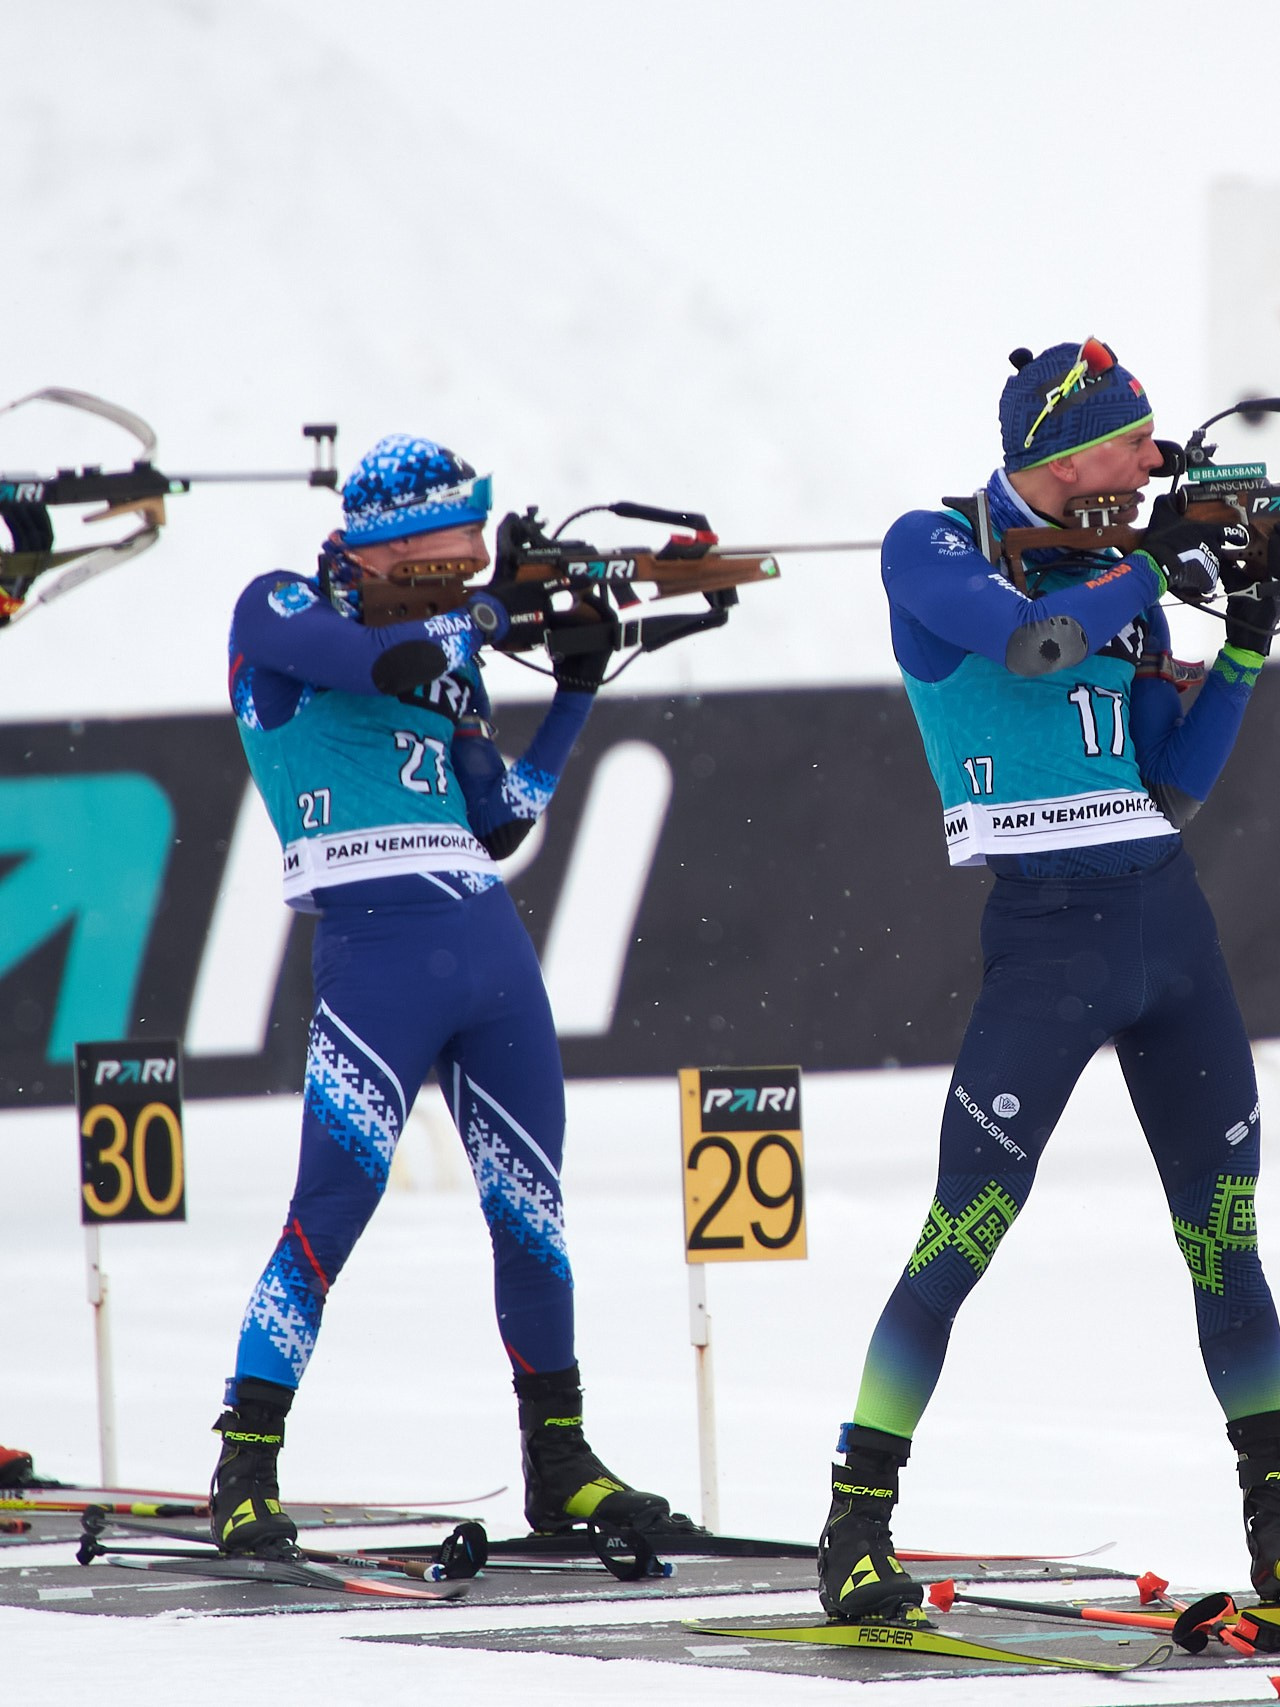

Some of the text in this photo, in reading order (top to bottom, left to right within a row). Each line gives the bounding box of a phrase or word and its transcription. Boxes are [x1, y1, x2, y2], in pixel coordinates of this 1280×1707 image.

[1201, 466, 1263, 478] BELARUSBANK
[568, 559, 635, 578] PARI
[1069, 683, 1124, 757] 17
[394, 731, 448, 795] 27
[964, 757, 995, 796] 17
[298, 787, 331, 830] 27
[992, 812, 1036, 829] PARI
[1041, 799, 1150, 824] ЧЕМПИОНАТ
[326, 841, 369, 861] PARI
[375, 834, 475, 854] ЧЕМПИОНАТ
[94, 1058, 176, 1085] PARI
[703, 1086, 796, 1113] PARI
[954, 1085, 1027, 1161] BELORUSNEFT
[82, 1102, 184, 1217] 30
[687, 1134, 803, 1250] 29
[224, 1430, 282, 1443] FISCHER
[833, 1481, 894, 1498] FISCHER
[858, 1628, 914, 1646] FISCHER
